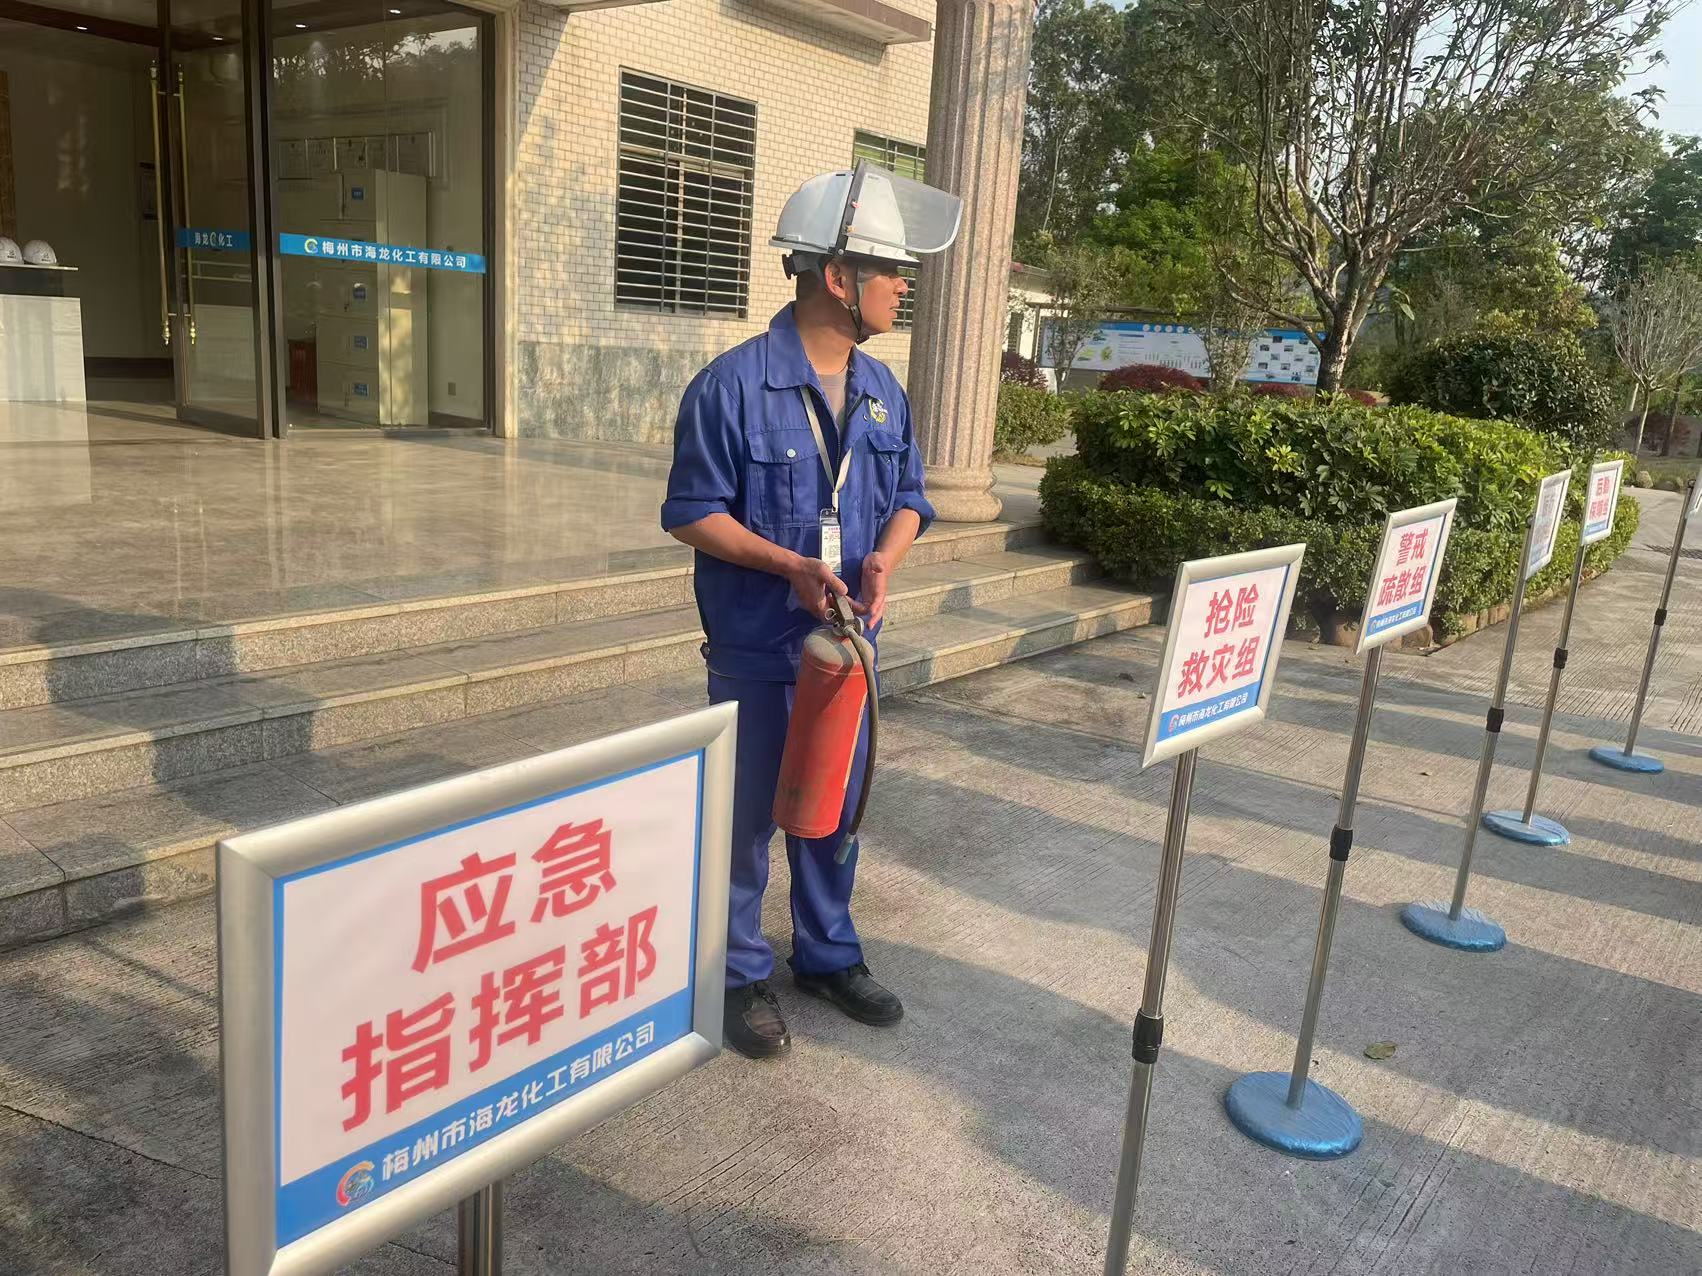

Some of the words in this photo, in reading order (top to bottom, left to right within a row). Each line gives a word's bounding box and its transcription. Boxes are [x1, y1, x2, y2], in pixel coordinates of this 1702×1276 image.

[321, 241, 467, 268] 梅州市海龙化工有限公司
[1396, 527, 1429, 567] 警戒
[1204, 583, 1260, 639] 抢险
[1377, 565, 1427, 606] 疏散组
[1177, 635, 1261, 699] 救灾组
[411, 816, 618, 973] 应急
[340, 904, 660, 1133] 指挥部
[381, 1020, 656, 1181] 梅州市海龙化工有限公司
